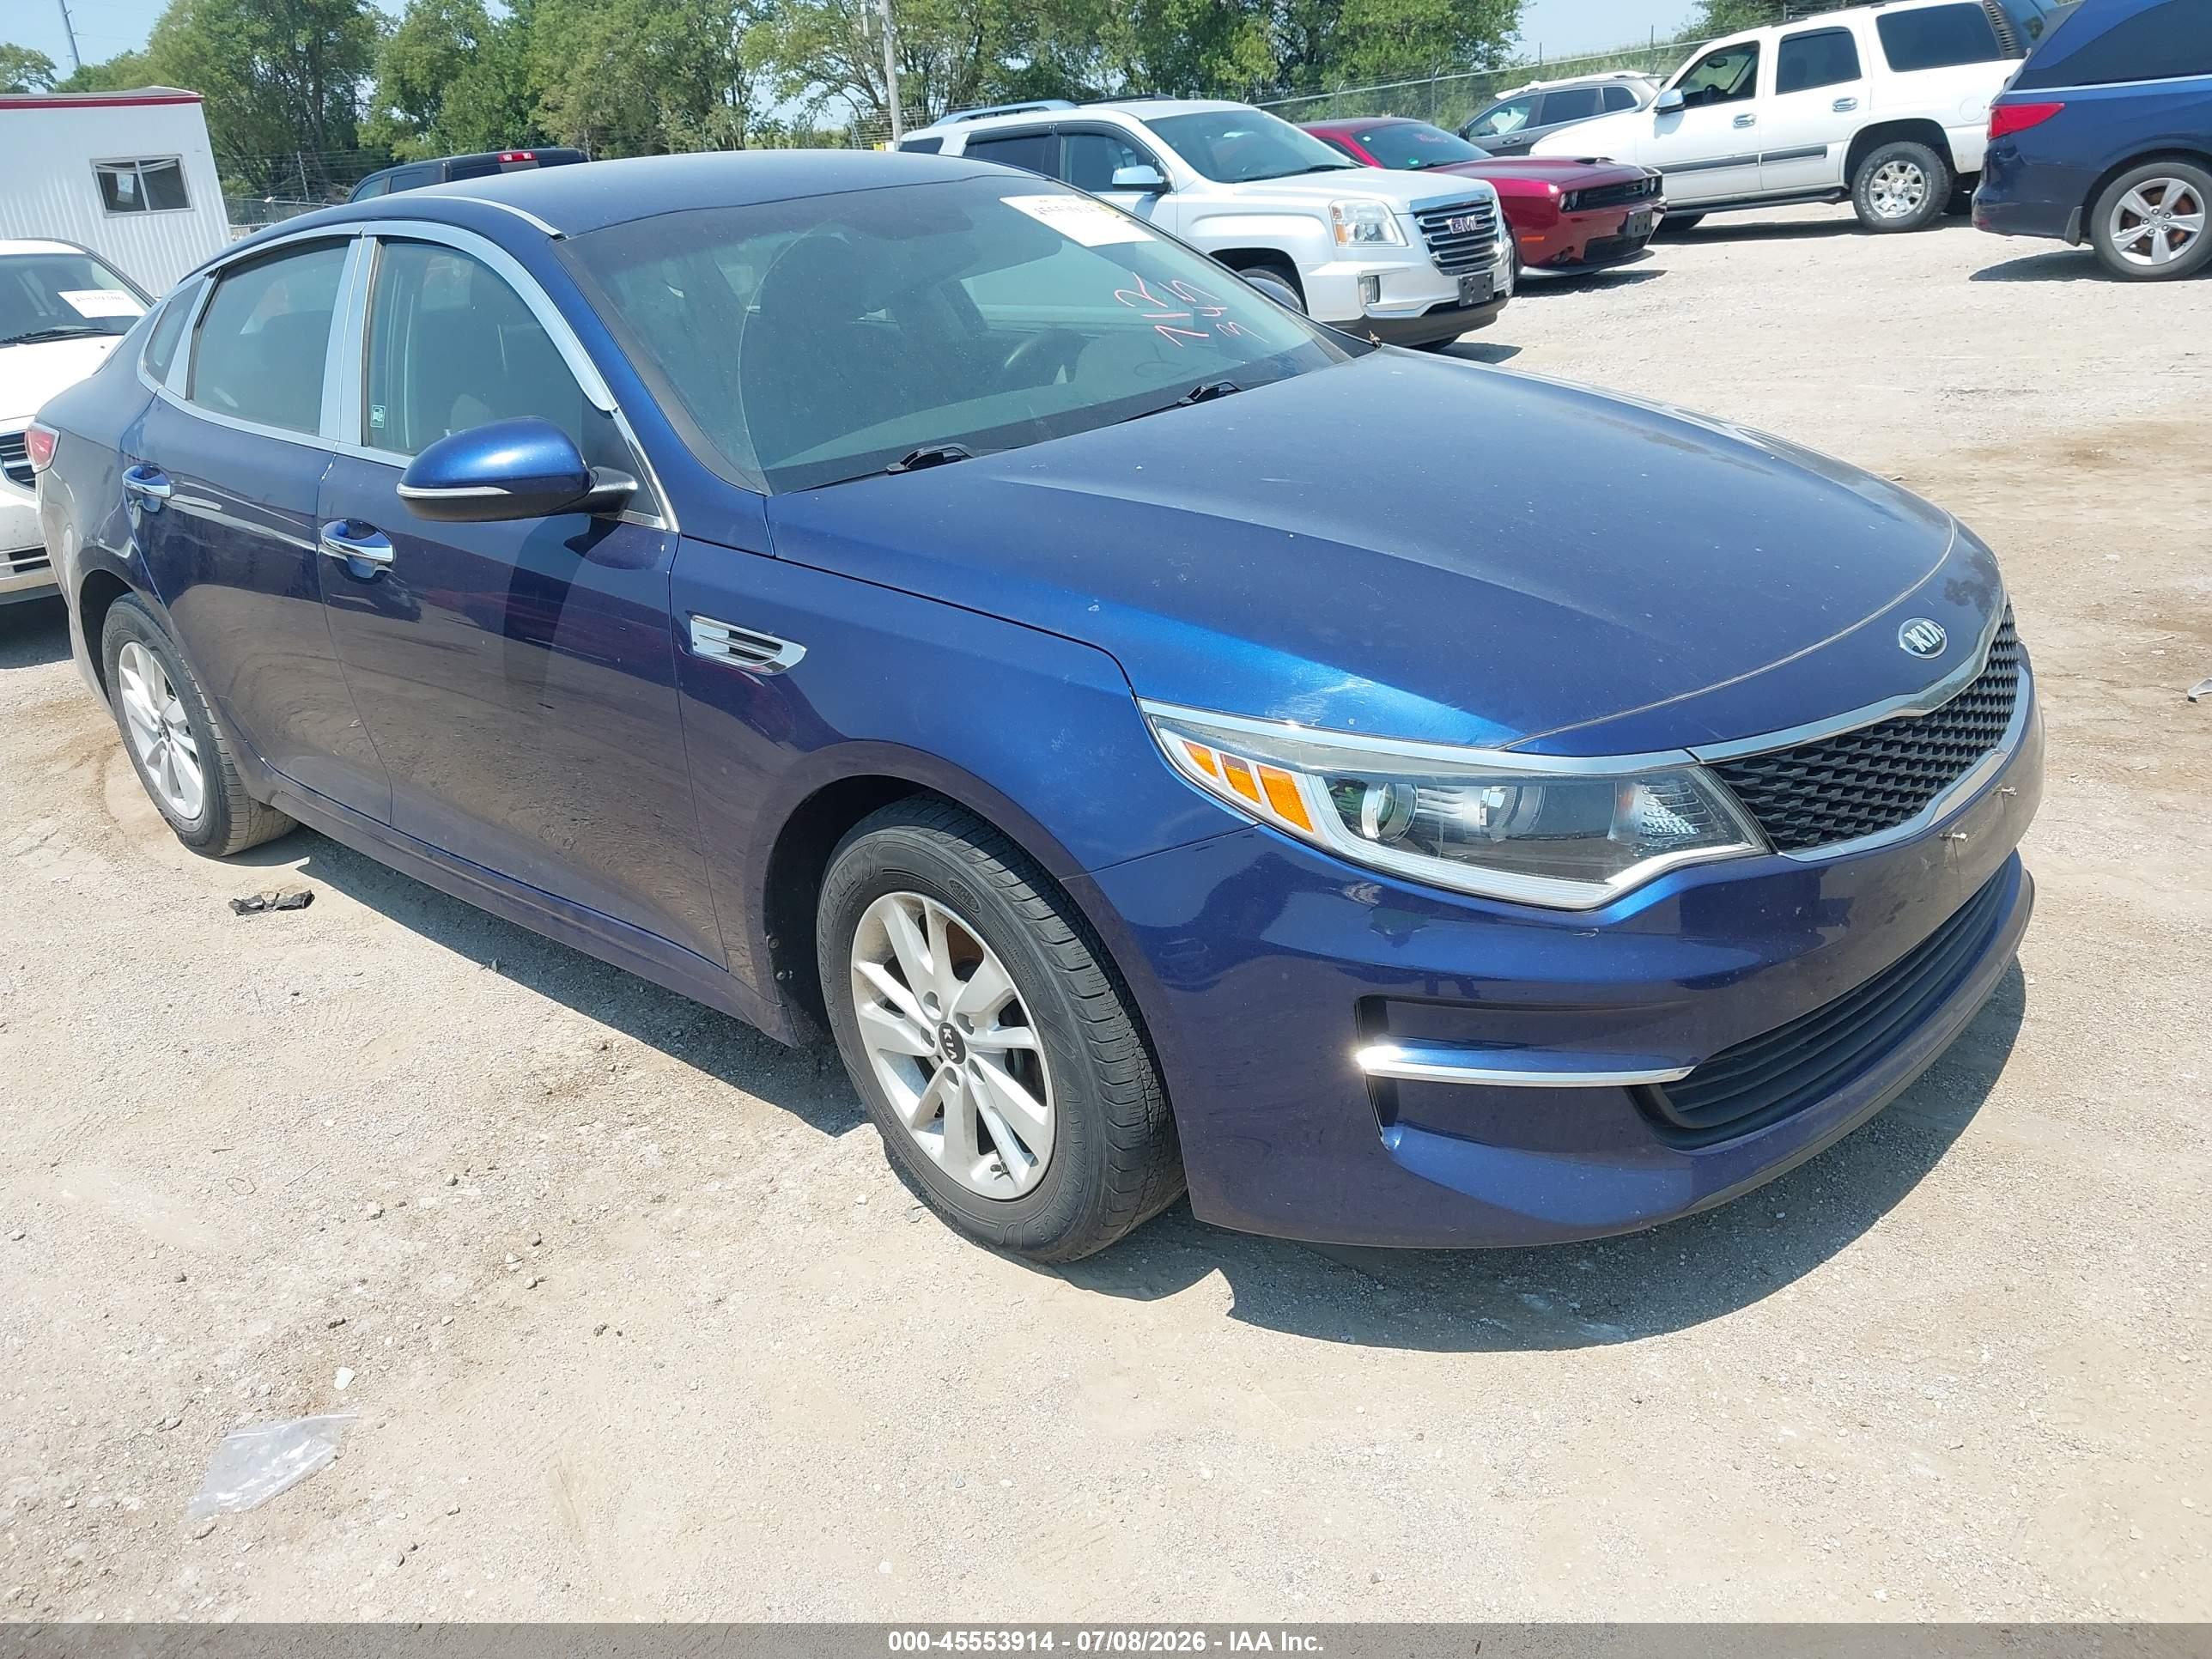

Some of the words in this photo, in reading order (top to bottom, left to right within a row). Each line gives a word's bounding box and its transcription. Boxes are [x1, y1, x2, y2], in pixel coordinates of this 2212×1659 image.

[1446, 214, 1485, 234] GMC
[1903, 620, 1945, 653] KIA
[942, 1027, 958, 1060] KIA
